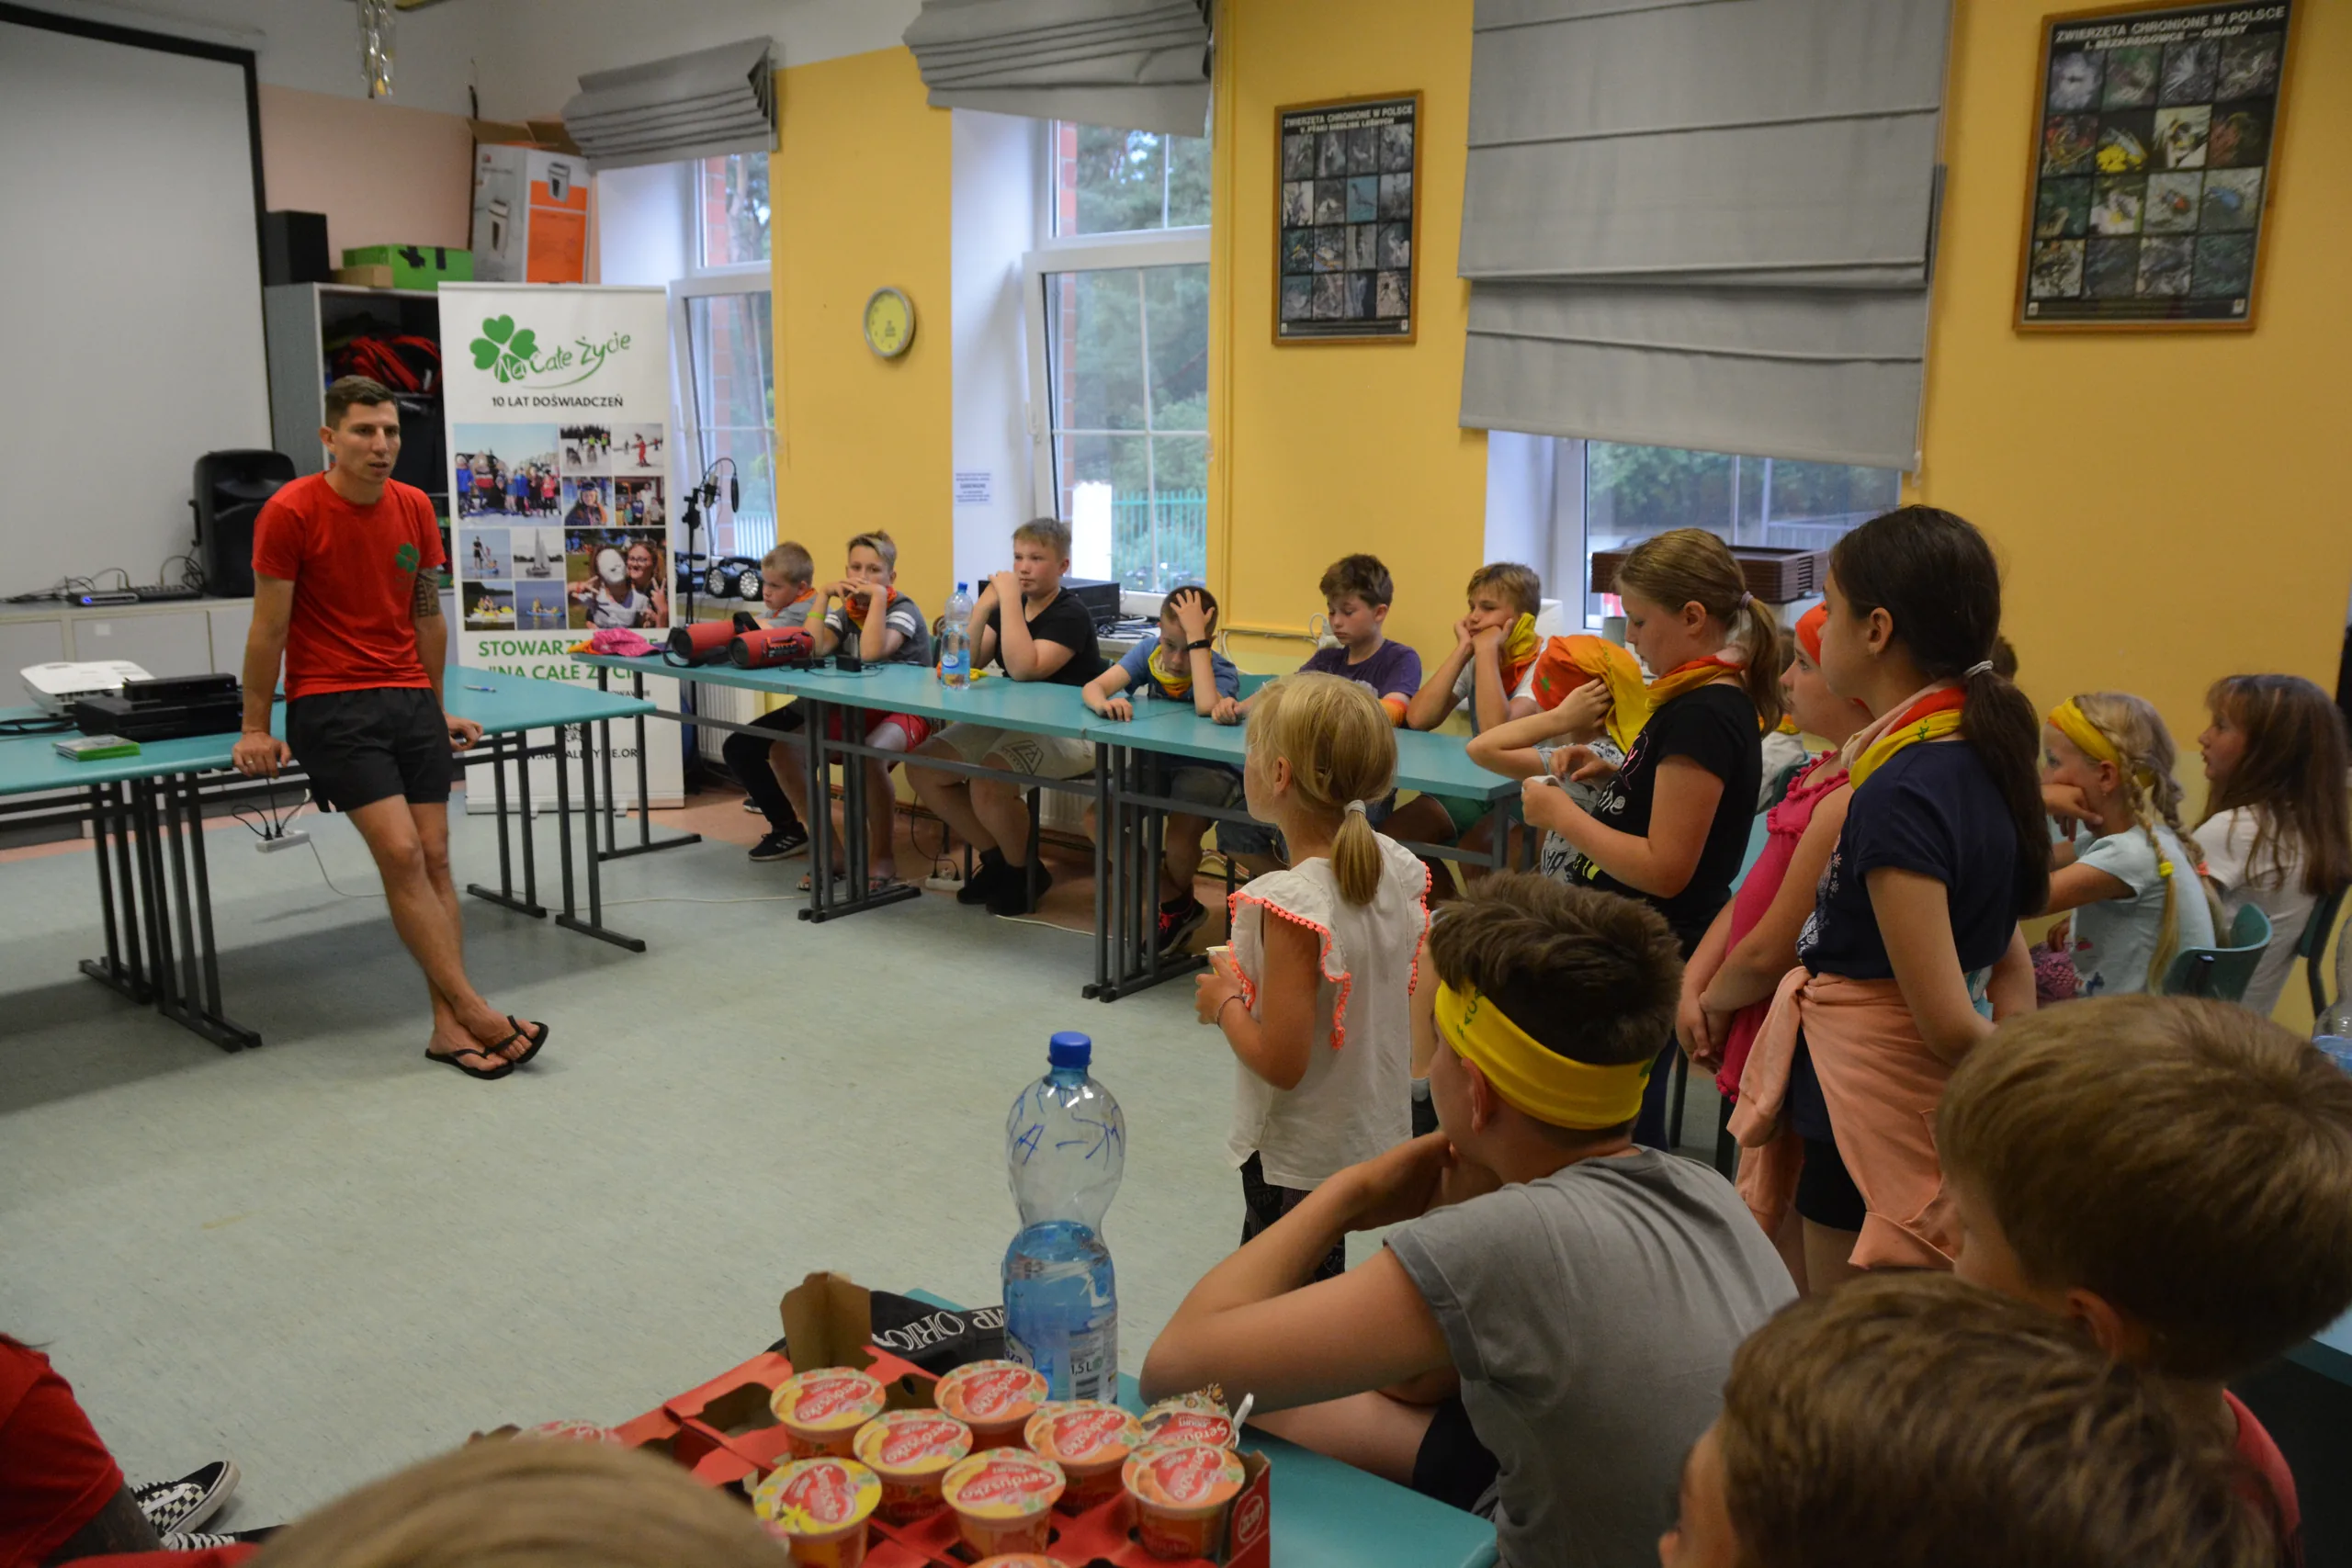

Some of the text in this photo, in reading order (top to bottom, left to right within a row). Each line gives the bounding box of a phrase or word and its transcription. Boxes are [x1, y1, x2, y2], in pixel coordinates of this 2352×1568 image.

[2132, 15, 2210, 35] CHRONIONE
[2212, 13, 2226, 25] W
[2228, 6, 2286, 24] POLSCE
[2200, 24, 2249, 39] OWADY
[1382, 105, 1413, 117] POLSCE
[530, 345, 573, 374] Całe
[575, 332, 632, 367] Życie
[492, 394, 624, 407] 10 LAT DOŚWIADCZEŃ
[532, 664, 580, 680] CAŁE
[1071, 1361, 1091, 1376] 1,5 L
[962, 1472, 1052, 1498] Serduszko
